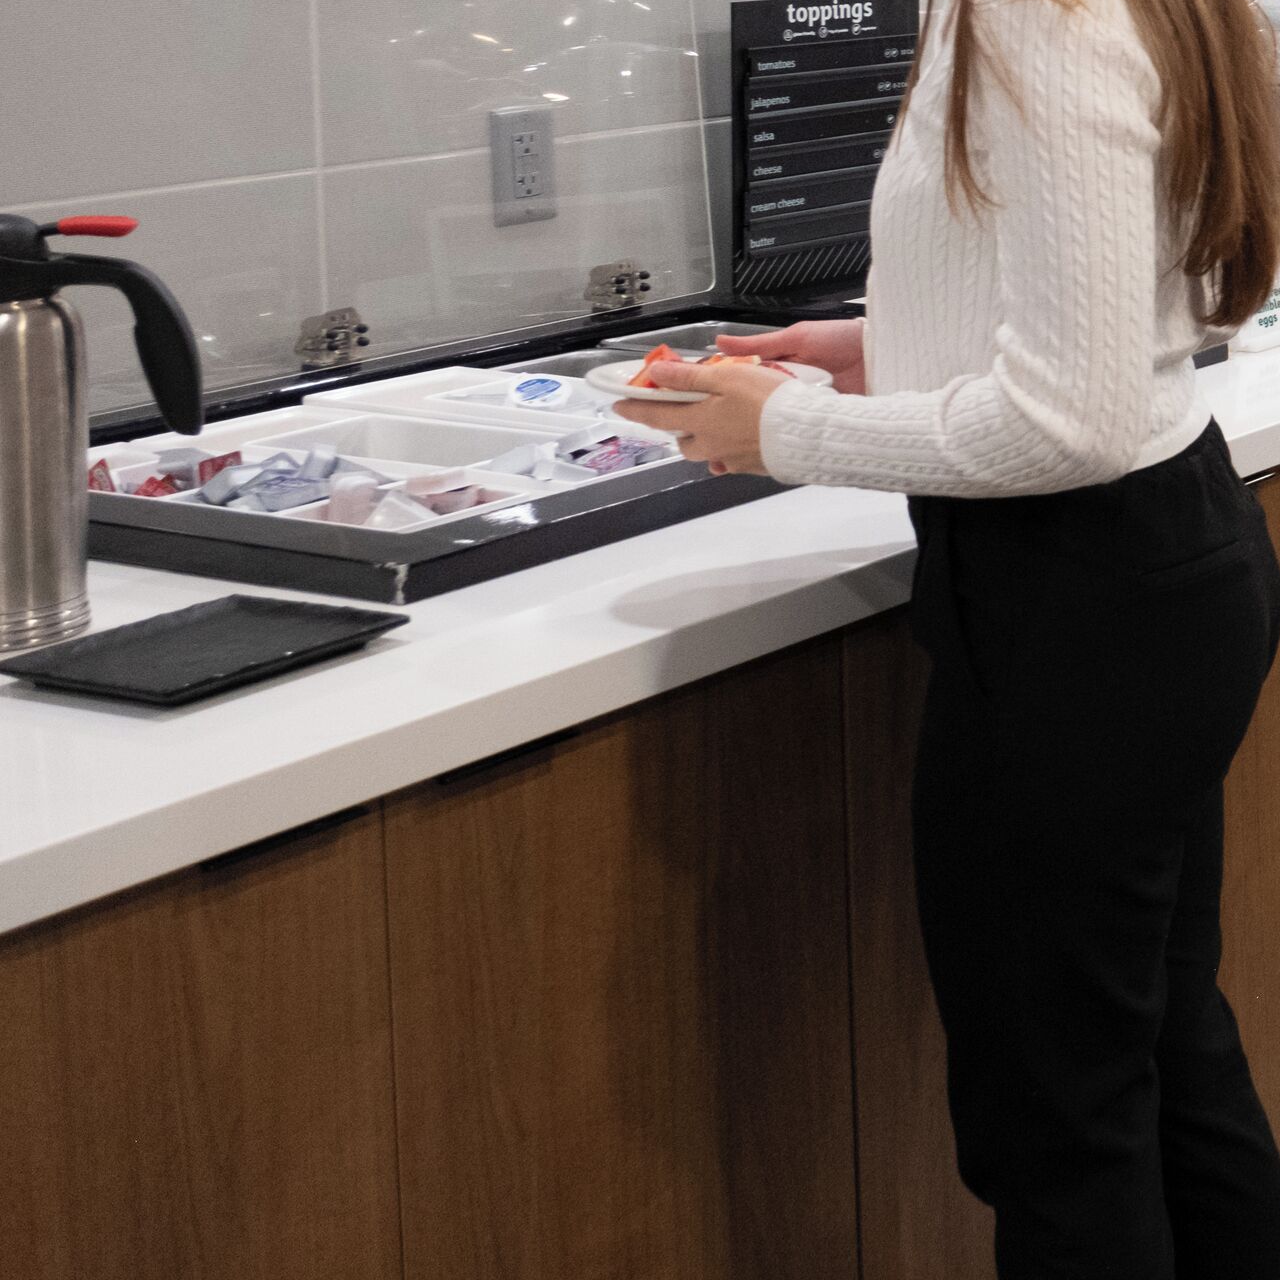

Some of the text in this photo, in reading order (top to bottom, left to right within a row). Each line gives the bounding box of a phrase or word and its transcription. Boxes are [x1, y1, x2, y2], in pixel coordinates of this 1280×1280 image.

[786, 0, 873, 26] toppings
[757, 58, 796, 71] tomatoes
[753, 130, 775, 143] salsa
[753, 164, 782, 177] cheese
[750, 196, 805, 213] cream cheese
[750, 235, 775, 248] butter
[1258, 314, 1278, 328] eggs
